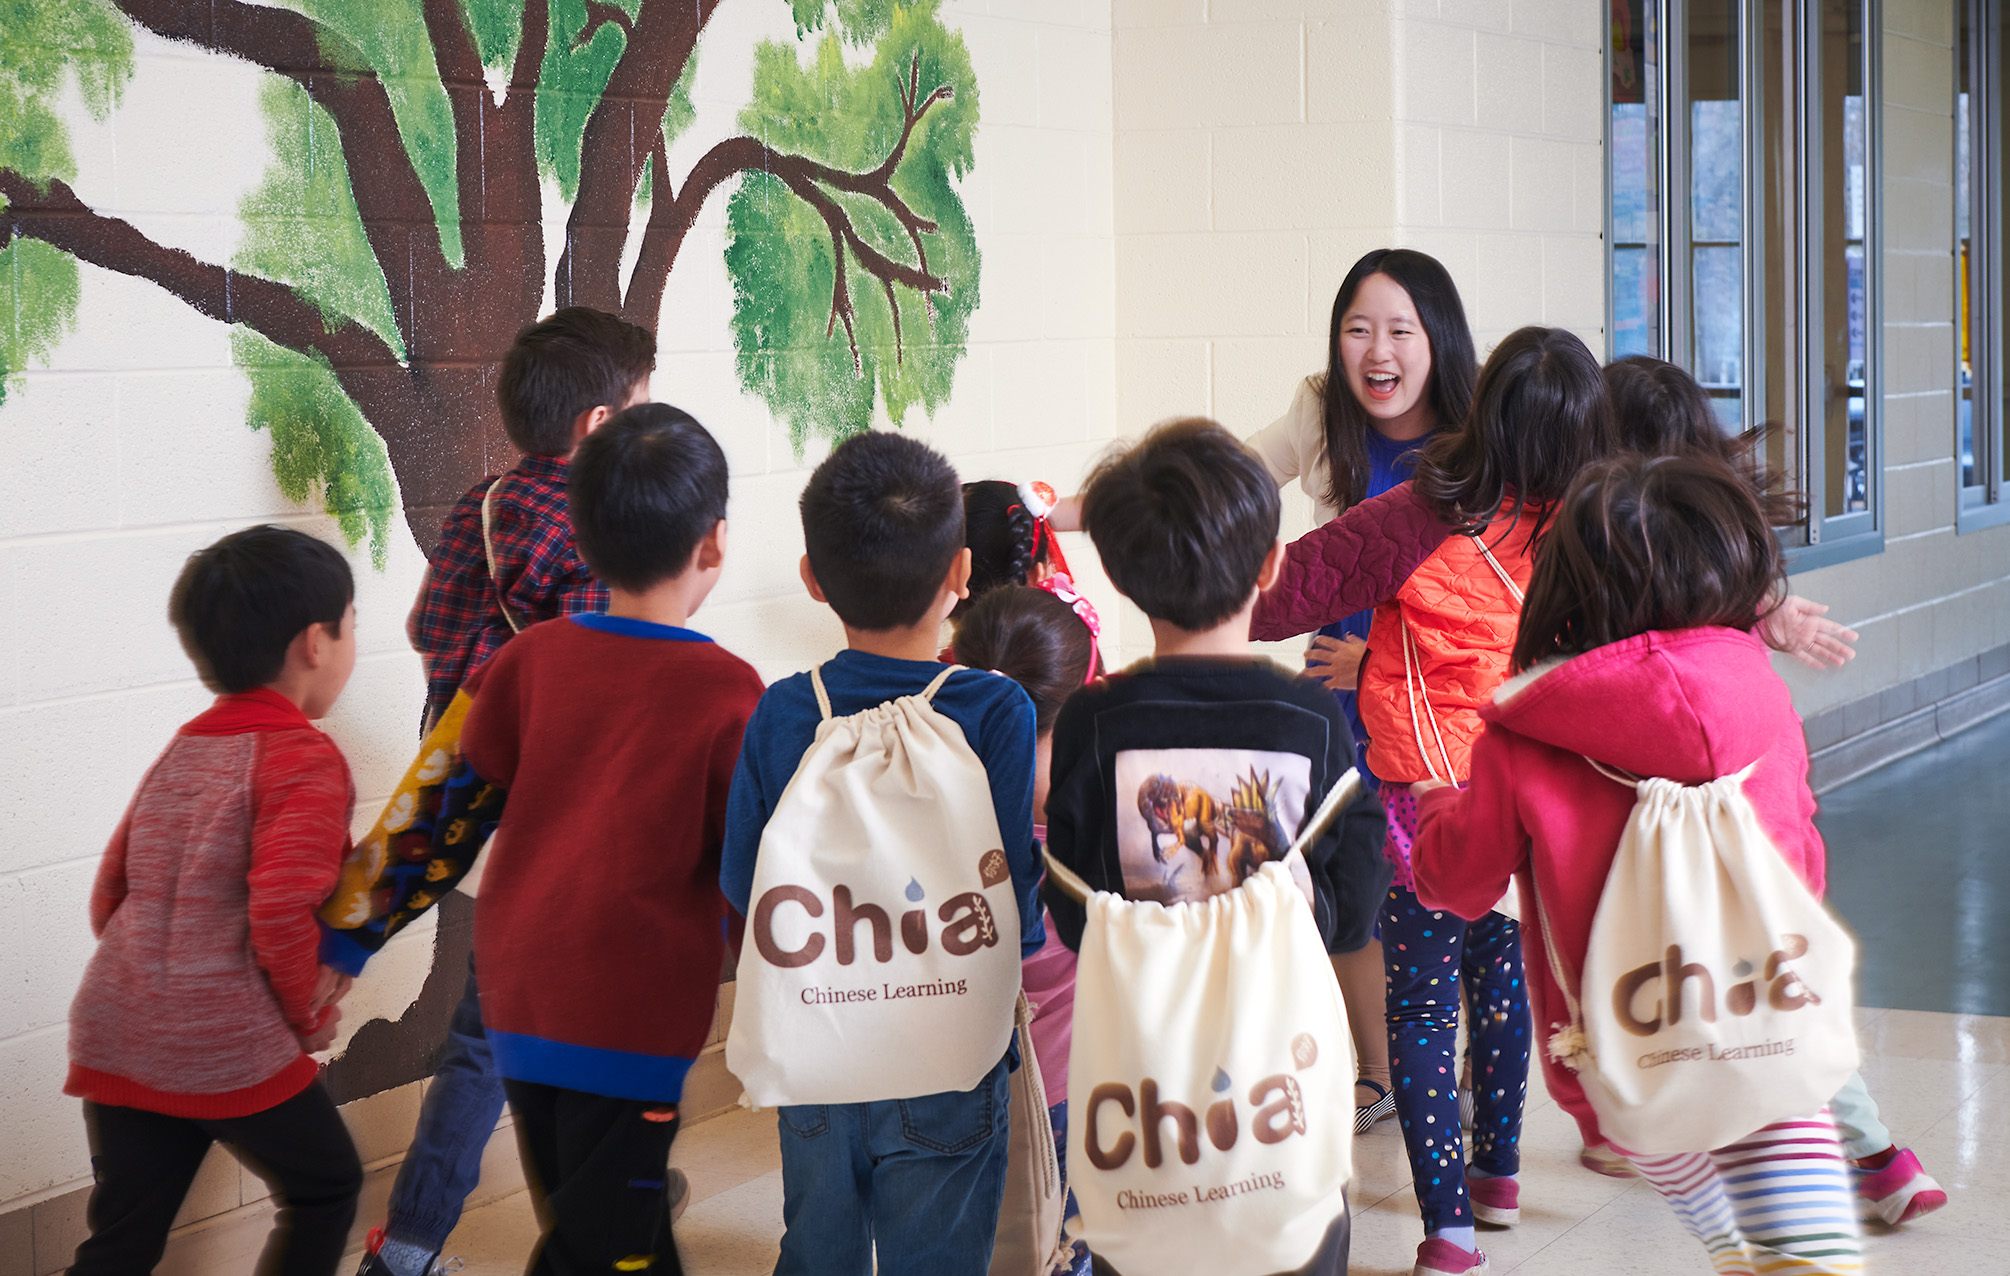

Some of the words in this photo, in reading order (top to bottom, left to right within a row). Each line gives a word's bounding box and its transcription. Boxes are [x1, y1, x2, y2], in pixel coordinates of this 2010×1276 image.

[753, 877, 998, 968] Chia
[801, 986, 877, 1005] Chinese
[883, 978, 968, 999] Learning
[1707, 1038, 1796, 1061] Learning
[1084, 1068, 1306, 1171] Chia
[1117, 1189, 1188, 1210] Chinese
[1192, 1171, 1285, 1203] Learning
